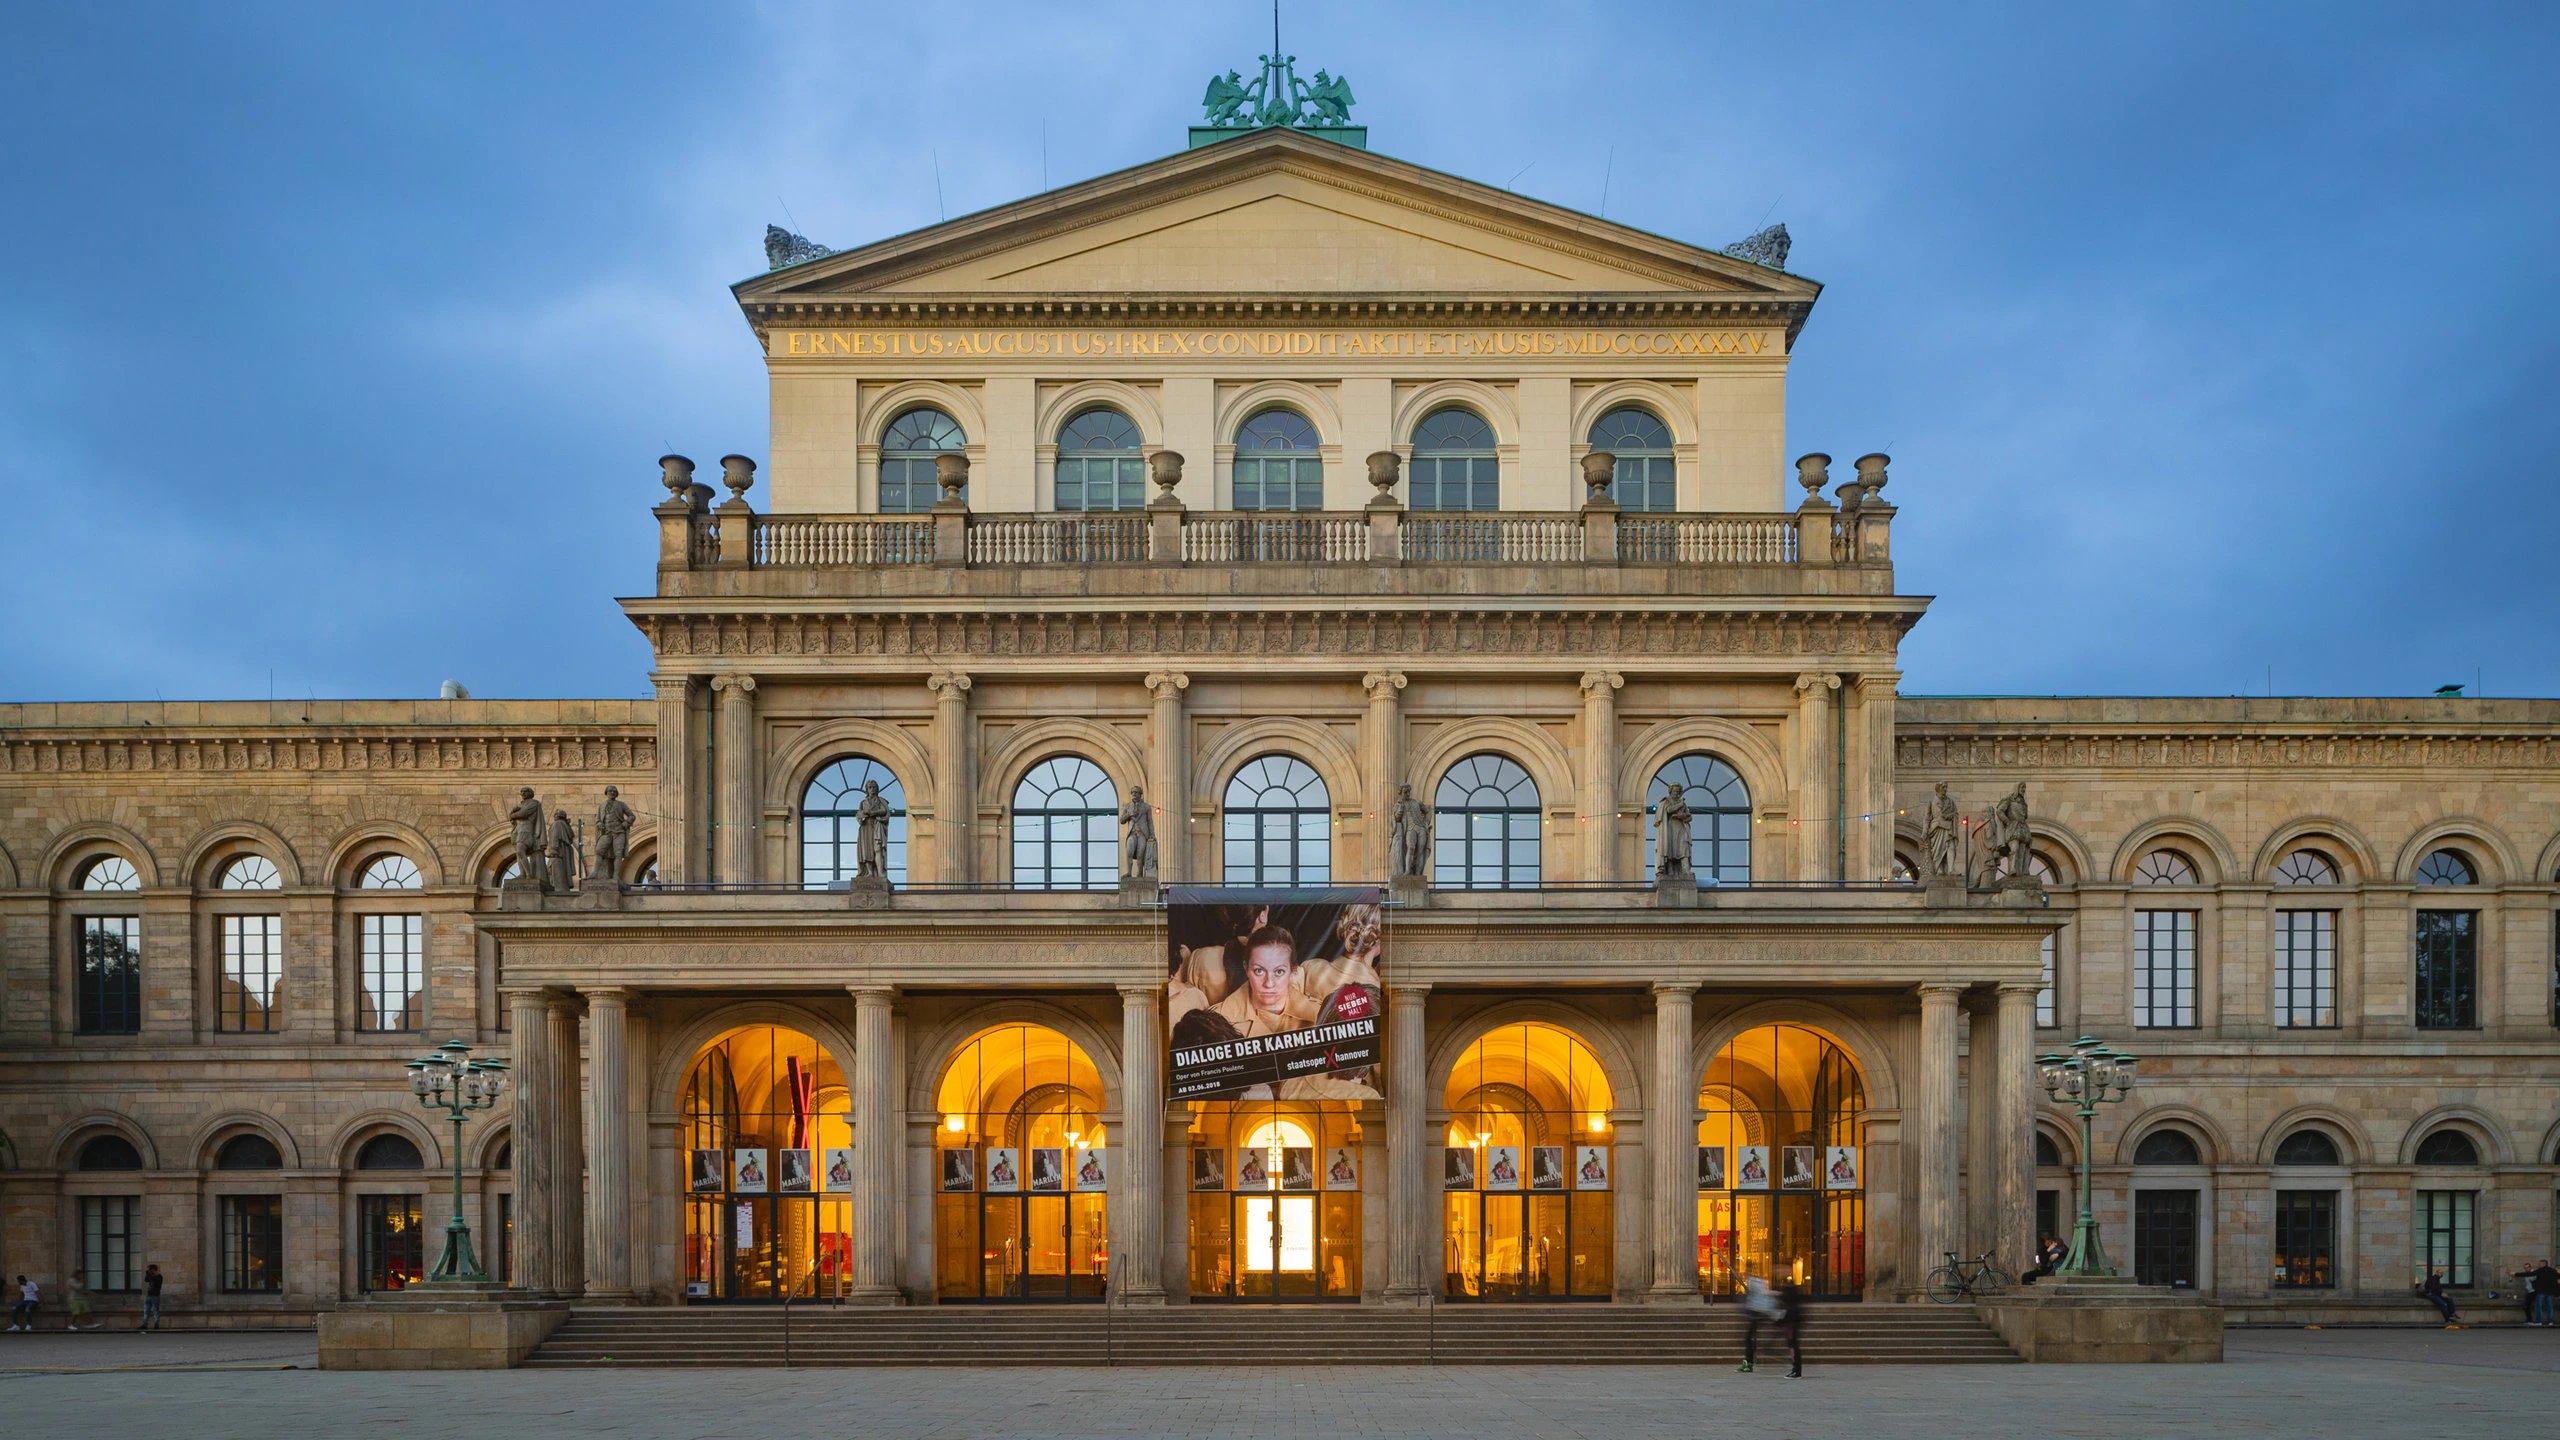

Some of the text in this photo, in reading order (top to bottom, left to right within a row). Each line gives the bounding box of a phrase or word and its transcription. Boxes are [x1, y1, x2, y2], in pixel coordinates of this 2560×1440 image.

[788, 332, 944, 354] ERNESTUS
[953, 332, 1107, 354] AUGUSTUS
[1131, 332, 1191, 354] REX
[1198, 332, 1345, 354] CONDIDIT
[1347, 332, 1416, 354] ARTI
[1423, 332, 1467, 354] ET
[1469, 332, 1559, 354] MUSIS
[1337, 996, 1368, 1012] SIEBEN
[1175, 1019, 1375, 1067] DIALOGE DER KARMELITINNEN
[1200, 1067, 1222, 1076] Francis
[1222, 1064, 1245, 1073] Poulenc
[1286, 1056, 1327, 1071] staatsoper
[1334, 1049, 1370, 1062] hannover
